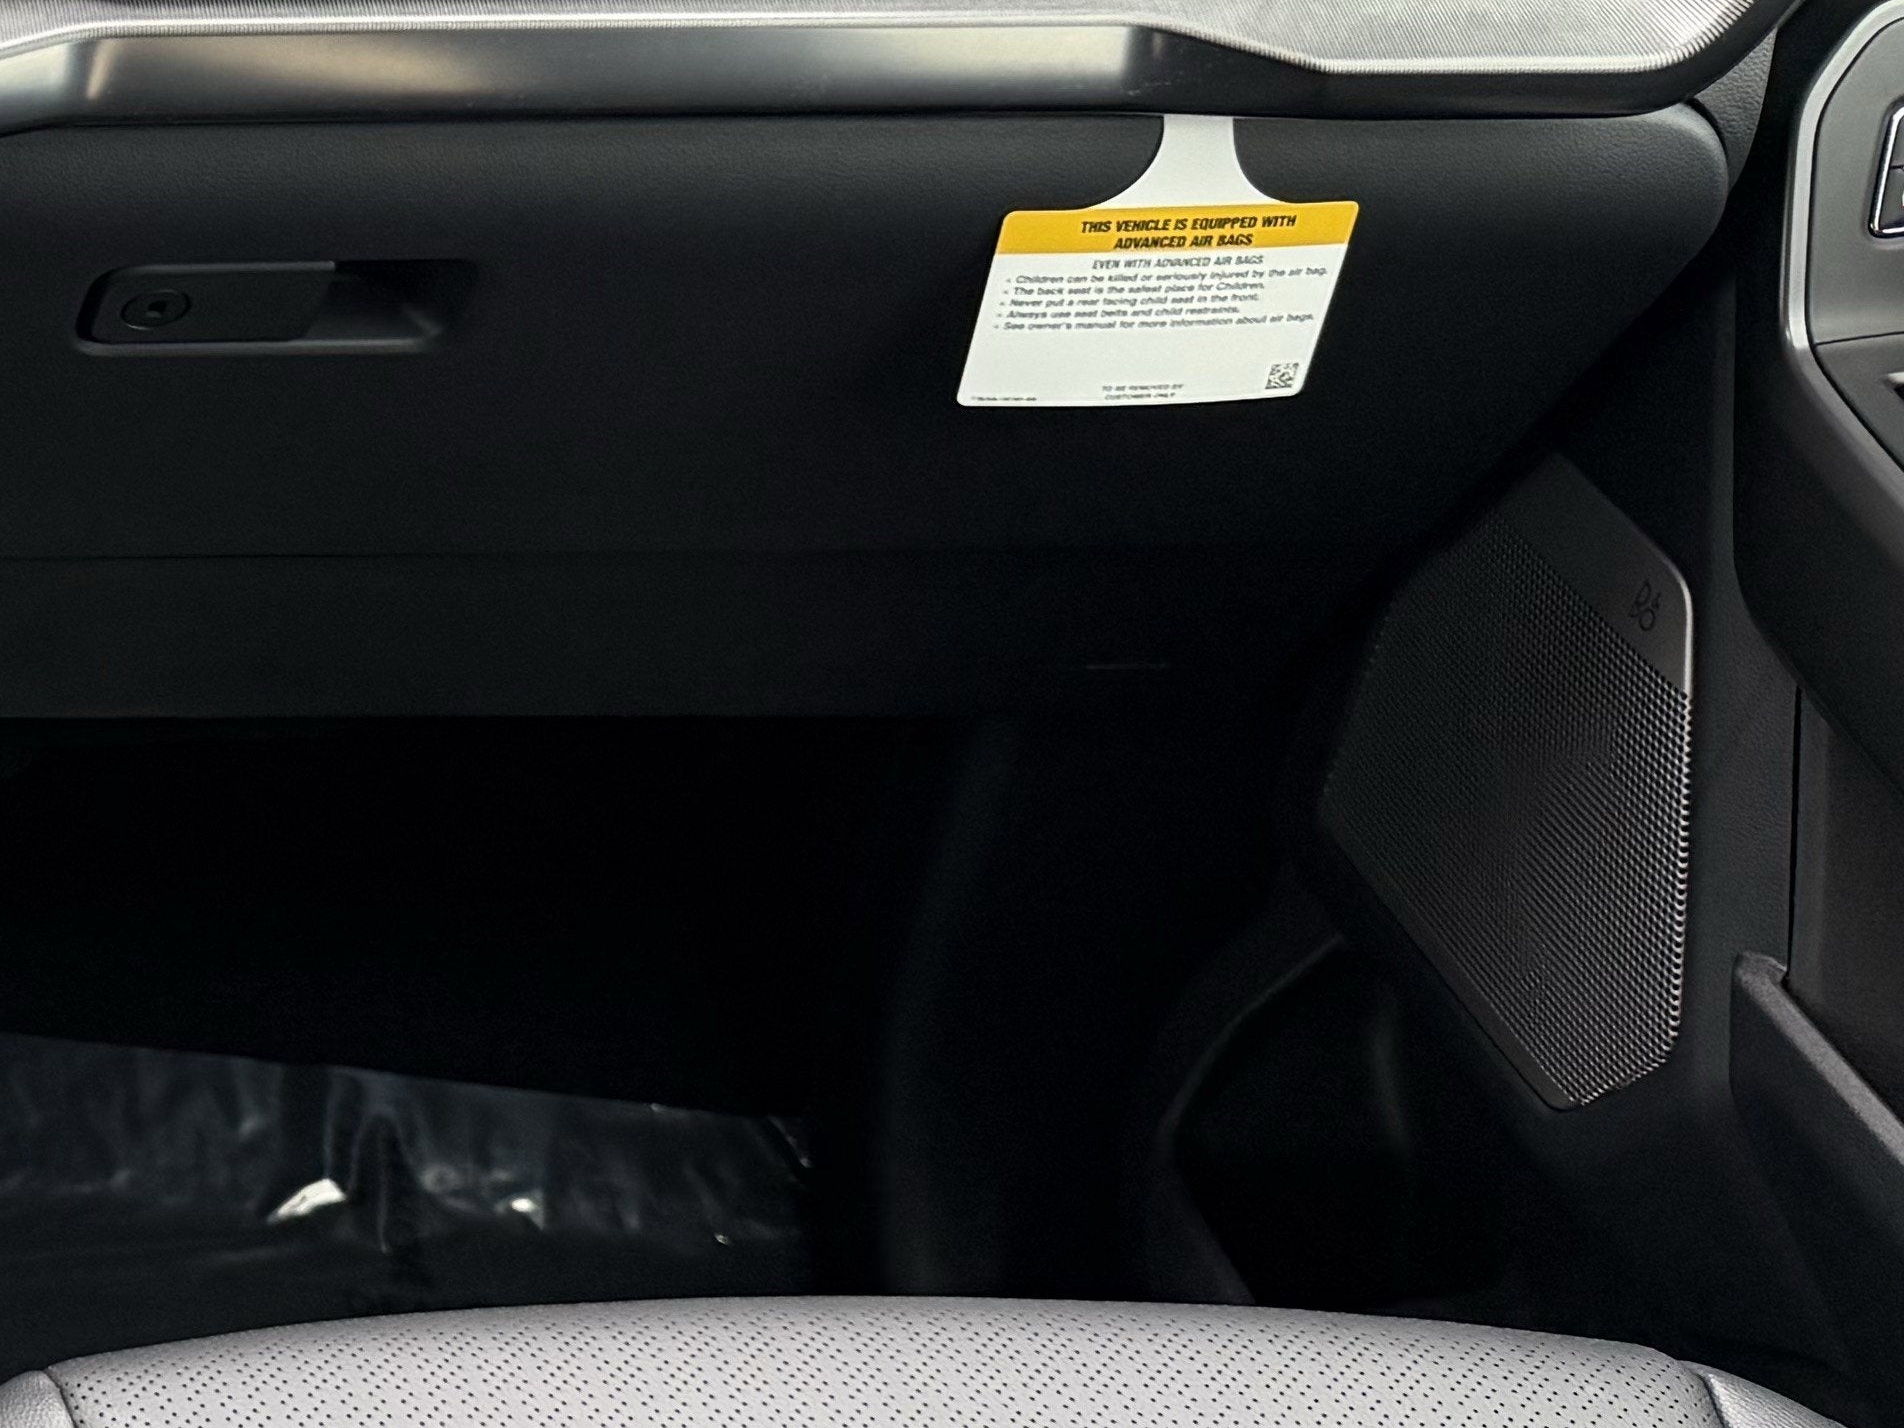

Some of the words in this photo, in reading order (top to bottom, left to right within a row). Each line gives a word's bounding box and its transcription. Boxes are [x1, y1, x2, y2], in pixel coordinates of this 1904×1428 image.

[1081, 220, 1112, 233] THIS
[1116, 218, 1169, 232] VEHICLE
[1173, 218, 1187, 231] IS
[1192, 216, 1257, 231] EQUIPPED
[1261, 214, 1297, 228] WITH
[1113, 235, 1187, 250] ADVANCED
[1189, 234, 1213, 247] AIR
[1217, 233, 1254, 246] BAGS
[1092, 259, 1120, 270] EVEN
[1124, 258, 1152, 268] WITH
[1155, 257, 1210, 268] ADVANCED
[1214, 256, 1233, 266] AIR
[1235, 255, 1264, 265] BAGS
[1016, 274, 1064, 284] Children
[1067, 275, 1087, 283] can
[1092, 274, 1104, 283] be
[1108, 273, 1138, 282] killed
[1141, 274, 1153, 282] or
[1156, 272, 1206, 282] seriously
[1210, 270, 1248, 281] injured
[1252, 270, 1264, 279] by
[1269, 268, 1285, 277] the
[1288, 268, 1303, 276] air
[1014, 286, 1034, 296] The
[1037, 286, 1064, 295] back
[1068, 286, 1091, 295] seat
[1107, 285, 1125, 294] the
[1164, 284, 1194, 294] place
[1198, 282, 1213, 292] for
[1009, 298, 1042, 307] Never
[1045, 298, 1064, 308] put
[1077, 298, 1100, 306] rear
[1140, 296, 1168, 305] child
[1171, 295, 1195, 304] seat
[1197, 294, 1208, 303] in
[1211, 294, 1228, 303] the
[1006, 310, 1047, 320] Always
[1074, 310, 1098, 319] seat
[1131, 308, 1153, 317] and
[1155, 307, 1182, 316] child
[1004, 322, 1025, 330] See
[1074, 320, 1116, 329] manual
[1120, 320, 1134, 329] for
[1137, 320, 1167, 328] more
[1169, 317, 1233, 327] information
[1235, 315, 1267, 325] about
[1270, 315, 1283, 323] air
